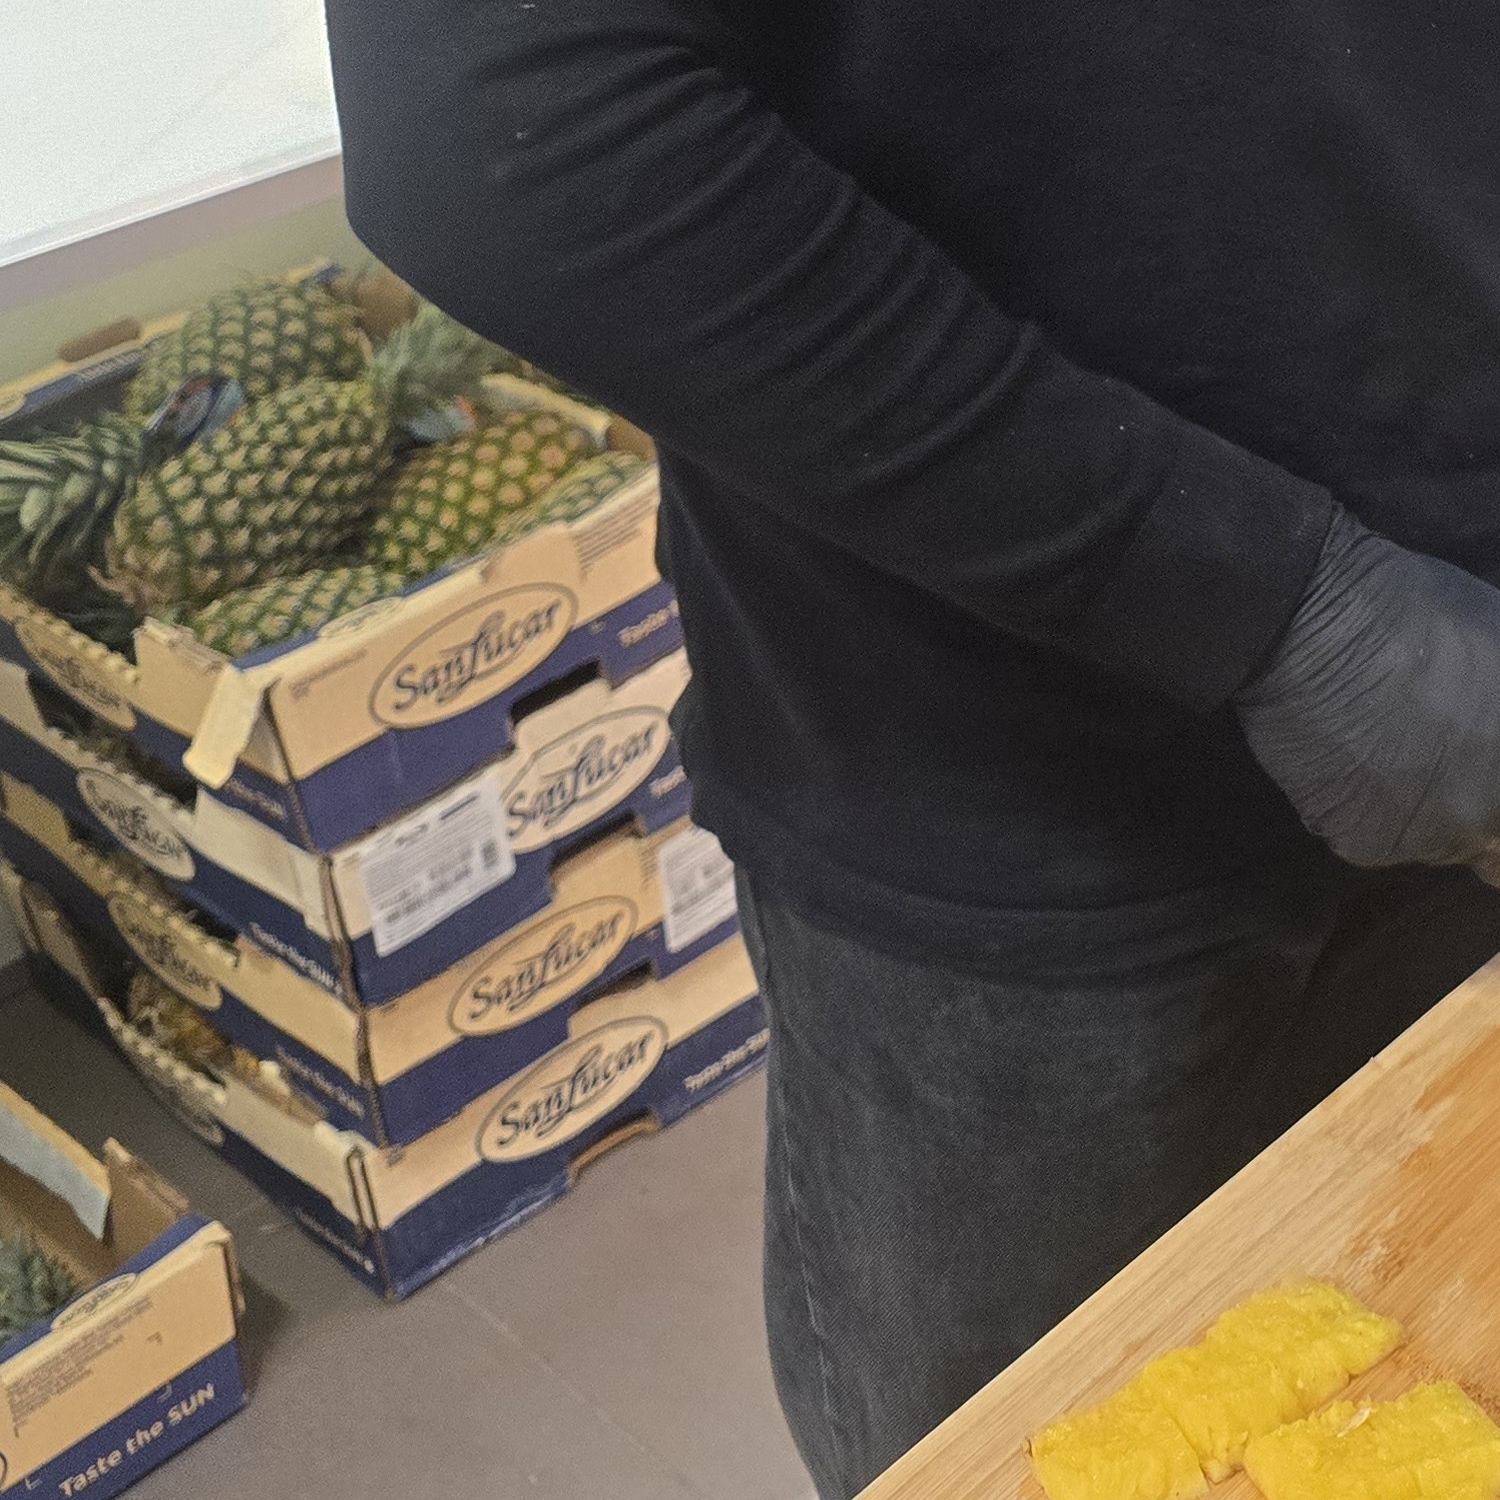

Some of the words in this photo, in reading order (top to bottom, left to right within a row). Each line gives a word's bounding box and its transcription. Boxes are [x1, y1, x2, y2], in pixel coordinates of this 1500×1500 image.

[394, 600, 561, 711] SanLucar
[506, 720, 659, 838] SanLucar
[468, 909, 627, 1021] SanLucar
[497, 1030, 655, 1146] SanLucar
[58, 1449, 122, 1497] Taste
[126, 1420, 164, 1455] the
[167, 1382, 216, 1425] SUN
